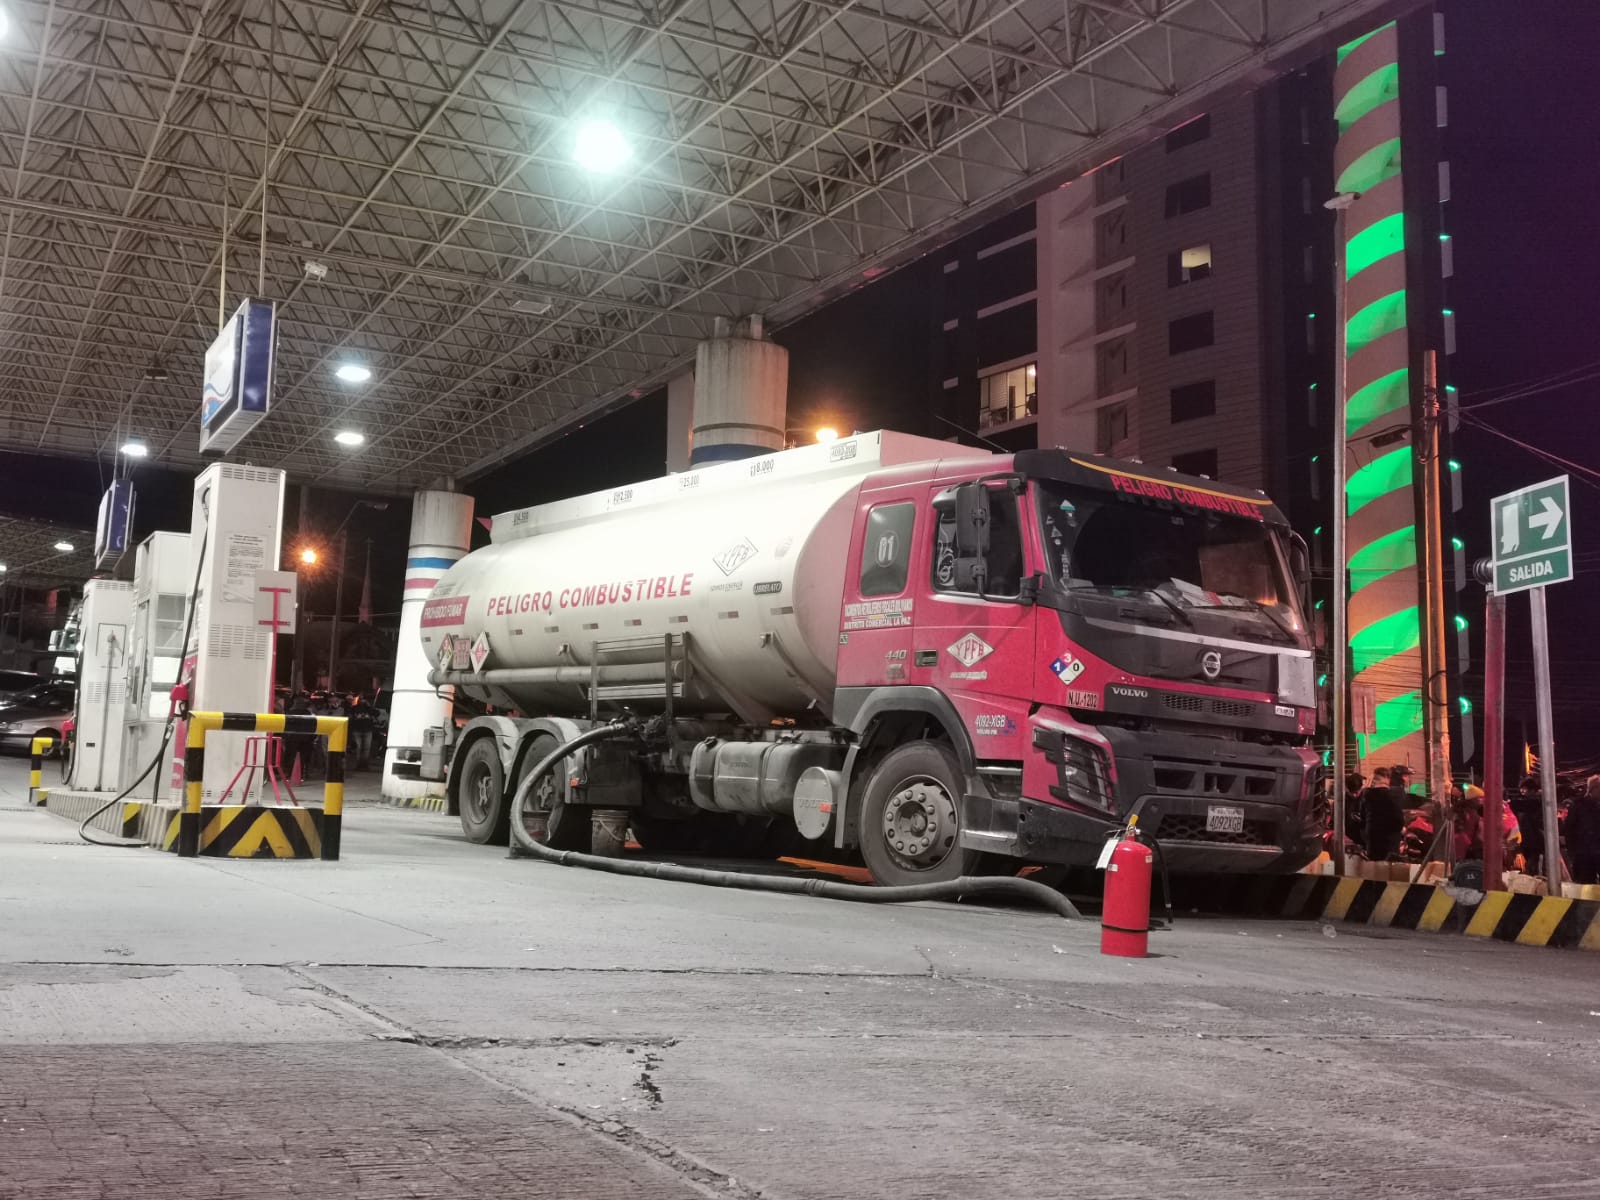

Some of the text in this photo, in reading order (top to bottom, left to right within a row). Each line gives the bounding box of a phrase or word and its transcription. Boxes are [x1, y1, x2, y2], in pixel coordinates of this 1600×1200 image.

[1110, 474, 1173, 500] PELIGRO
[1173, 488, 1264, 520] COMBUSTIBLE
[878, 536, 895, 561] 01
[1510, 560, 1553, 582] SALIDA
[486, 573, 694, 616] PELIGRO COMBUSTIBLE
[893, 616, 901, 626] LA
[901, 615, 912, 625] PAZ
[885, 649, 907, 660] 440
[955, 639, 985, 660] YPFB
[1063, 652, 1072, 662] 3
[1054, 662, 1080, 671] 1 0
[1110, 686, 1149, 698] VOLVO
[975, 714, 1006, 728] 4092-XGB
[1209, 816, 1241, 831] 4092XGB
